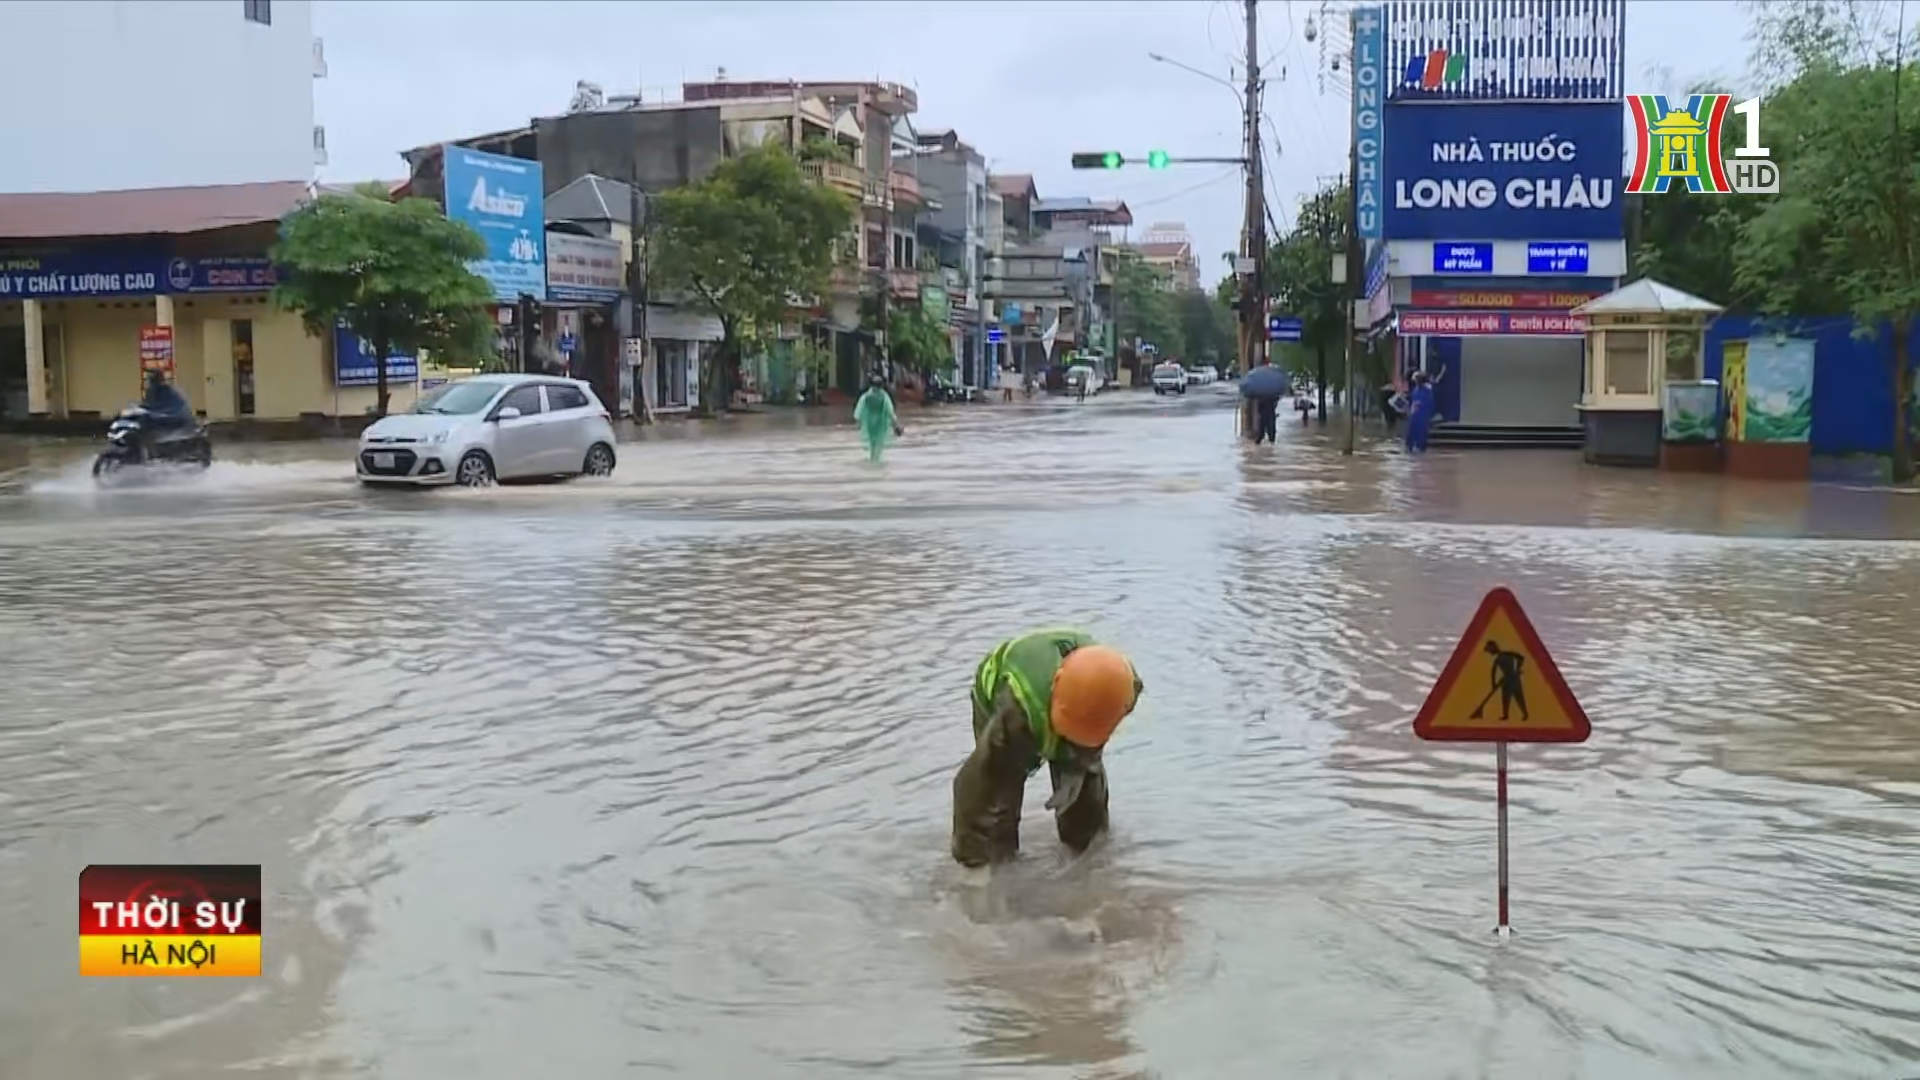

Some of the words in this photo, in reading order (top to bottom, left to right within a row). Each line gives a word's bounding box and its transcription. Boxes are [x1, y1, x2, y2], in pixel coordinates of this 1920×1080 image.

[1356, 42, 1379, 130] LONG
[1432, 136, 1484, 163] NHÀ
[1490, 133, 1576, 162] THUỐC
[1356, 141, 1379, 230] CHÂU
[1395, 178, 1497, 209] LONG
[1505, 174, 1613, 209] CHÂU
[14, 276, 25, 293] Y
[28, 270, 68, 293] CHẤT
[70, 272, 122, 294] LƯỢNG
[124, 272, 156, 289] CAO
